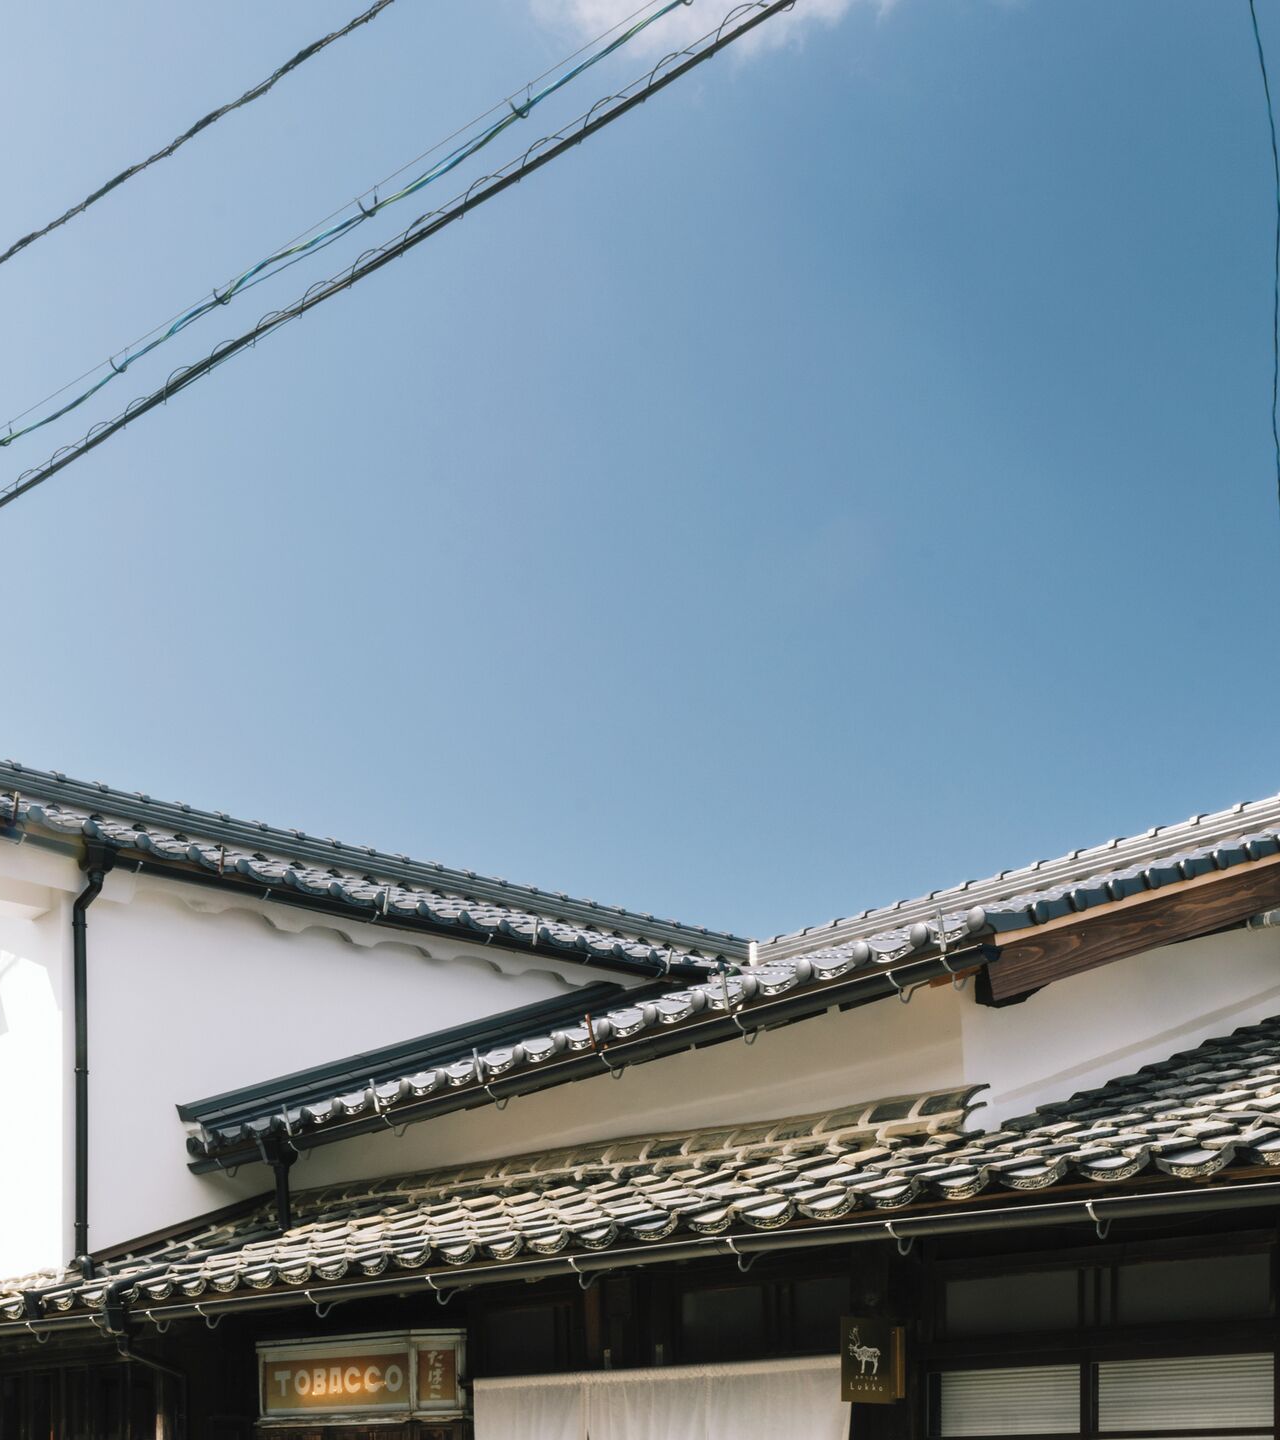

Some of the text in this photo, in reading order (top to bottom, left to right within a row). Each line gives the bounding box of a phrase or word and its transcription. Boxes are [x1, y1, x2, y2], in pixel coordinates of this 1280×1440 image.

[274, 1364, 404, 1398] TOBACCO
[427, 1350, 444, 1399] たばこ
